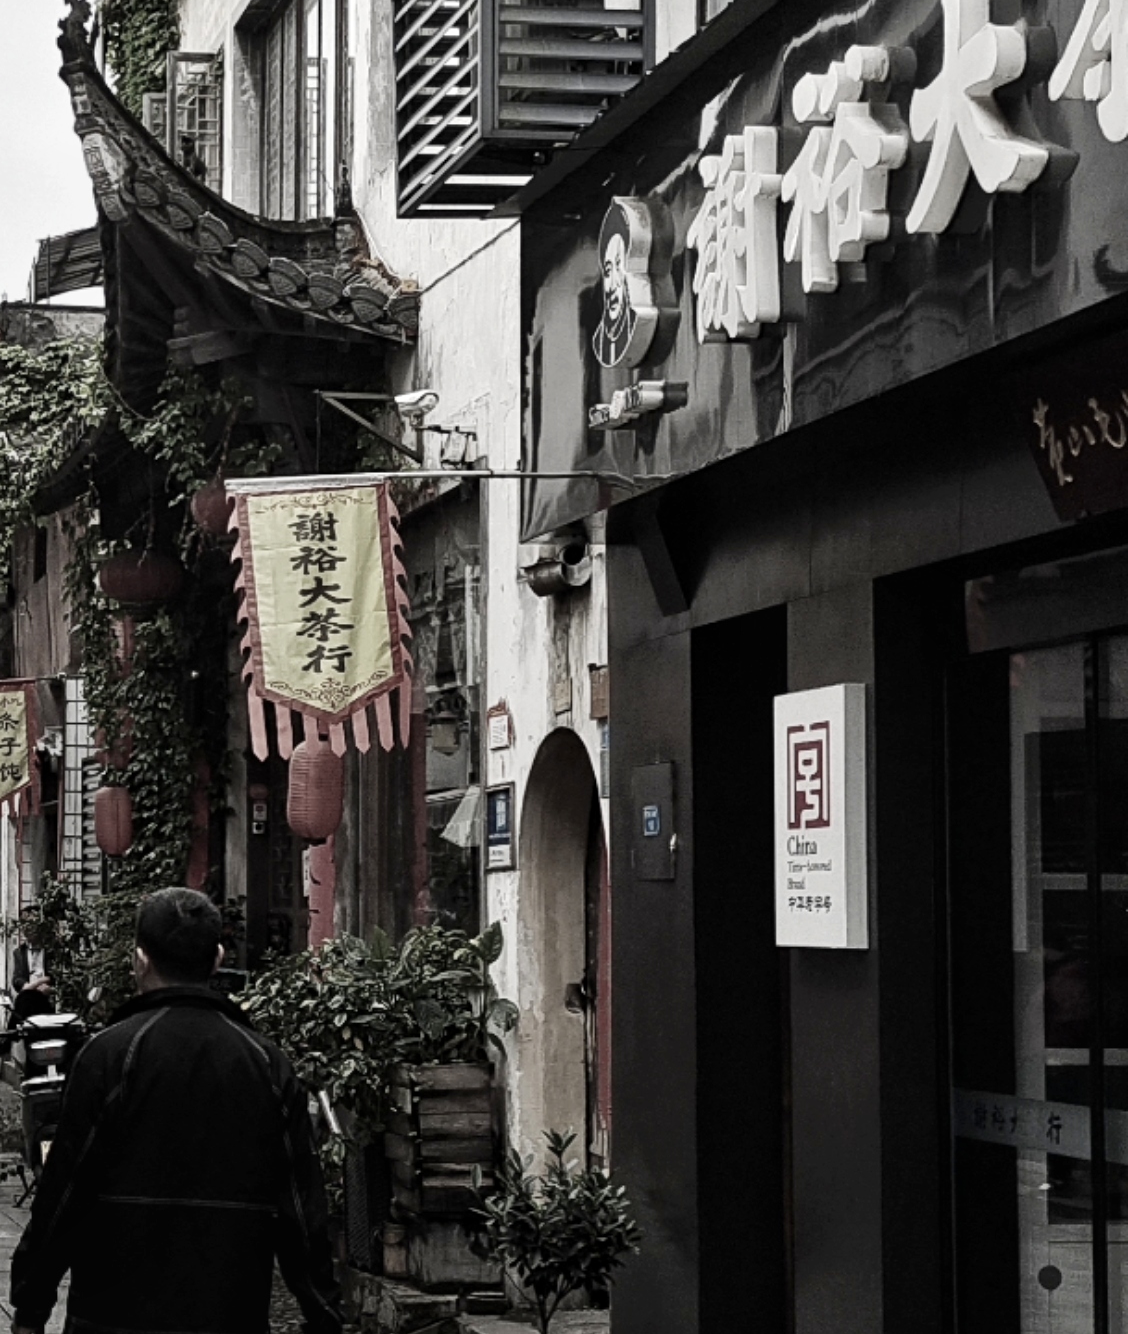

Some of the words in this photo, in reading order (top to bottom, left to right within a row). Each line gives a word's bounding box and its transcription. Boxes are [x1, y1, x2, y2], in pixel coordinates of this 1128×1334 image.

[288, 511, 355, 674] 謝裕大茶行
[786, 834, 818, 857] China
